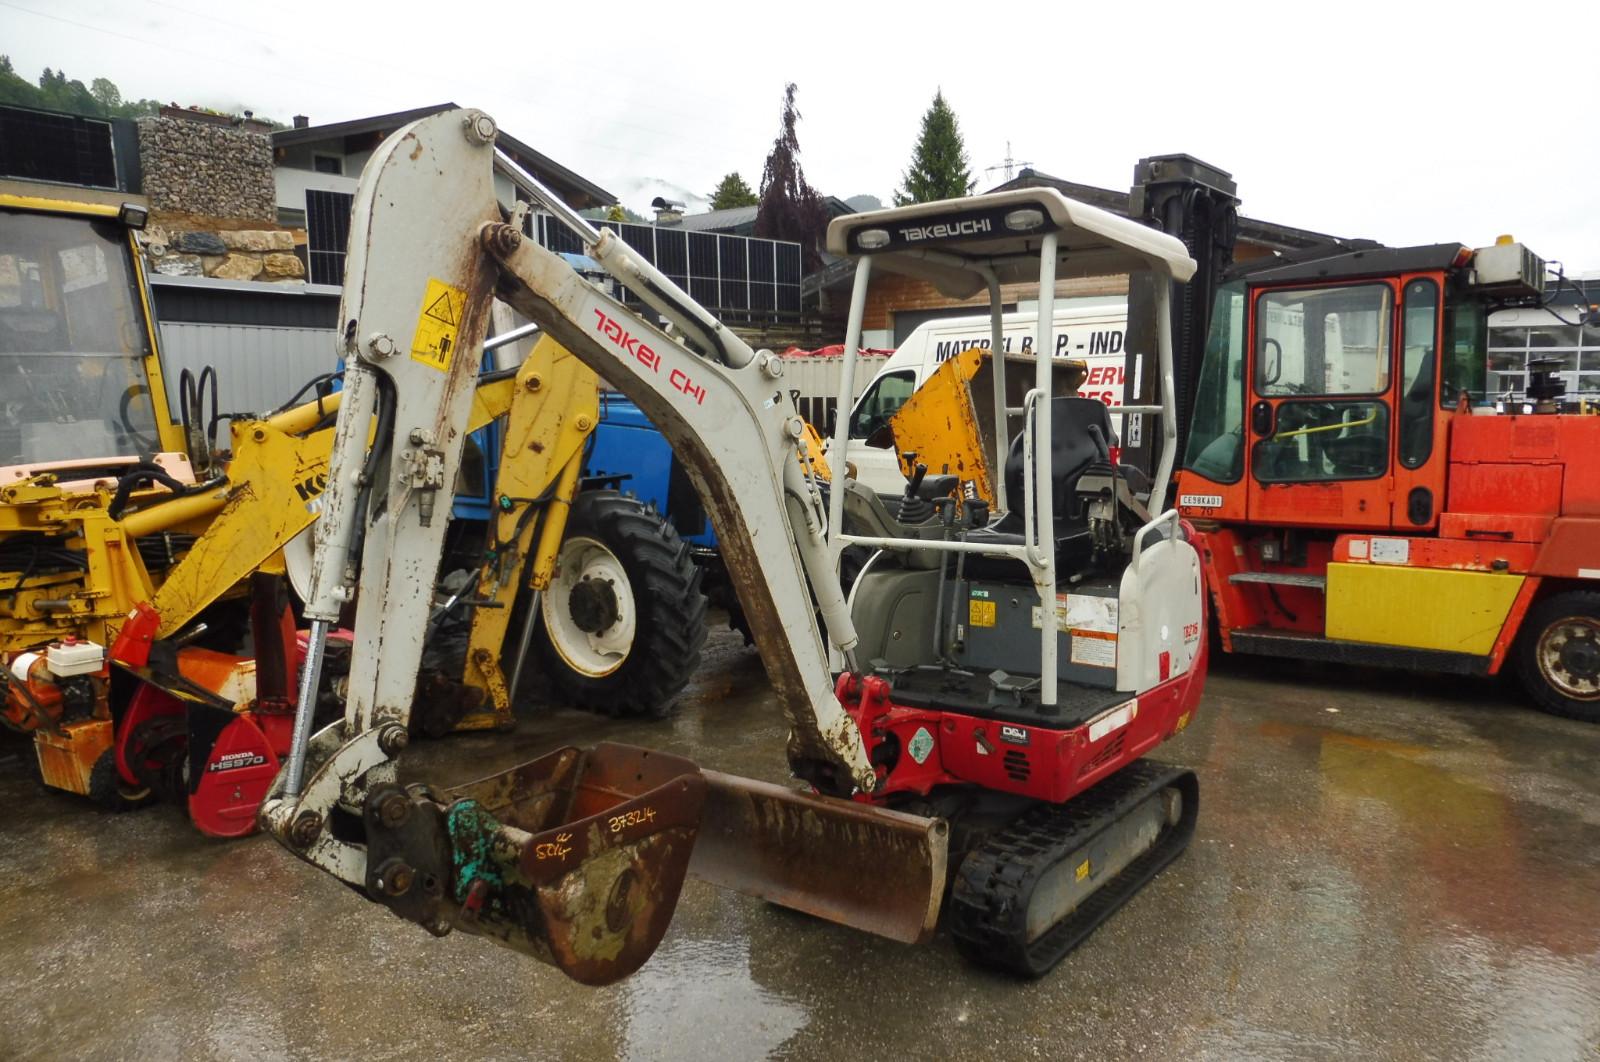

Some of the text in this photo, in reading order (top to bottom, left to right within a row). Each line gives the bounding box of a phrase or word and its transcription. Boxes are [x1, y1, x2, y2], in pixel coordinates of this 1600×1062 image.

[899, 218, 991, 242] TAKEUCHI
[210, 755, 264, 771] HS970
[221, 751, 254, 761] HONDA
